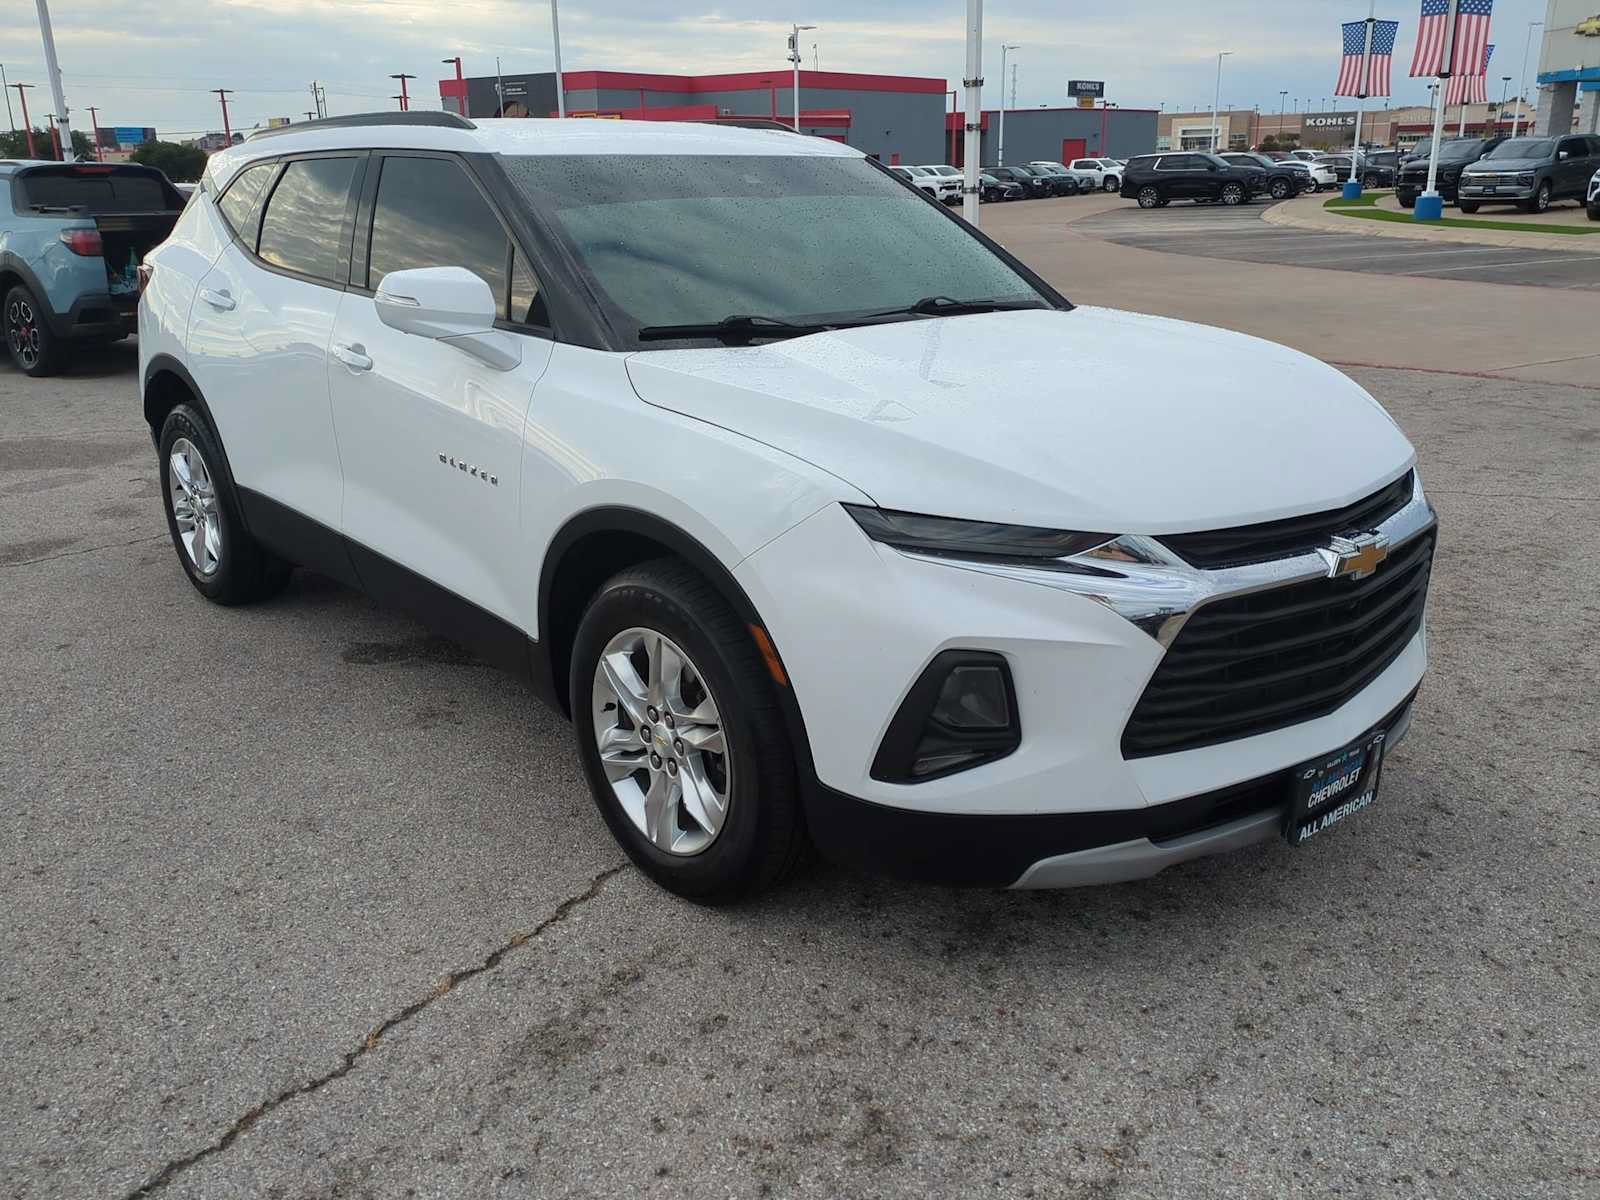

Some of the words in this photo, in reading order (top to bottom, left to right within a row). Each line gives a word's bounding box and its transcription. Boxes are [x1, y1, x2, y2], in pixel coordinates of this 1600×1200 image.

[1306, 116, 1355, 126] KOHL'S
[439, 452, 498, 487] BLAZER
[1307, 766, 1362, 808] CHEVROLET
[1299, 820, 1319, 841] ALL
[1320, 791, 1374, 830] AMERICAN
